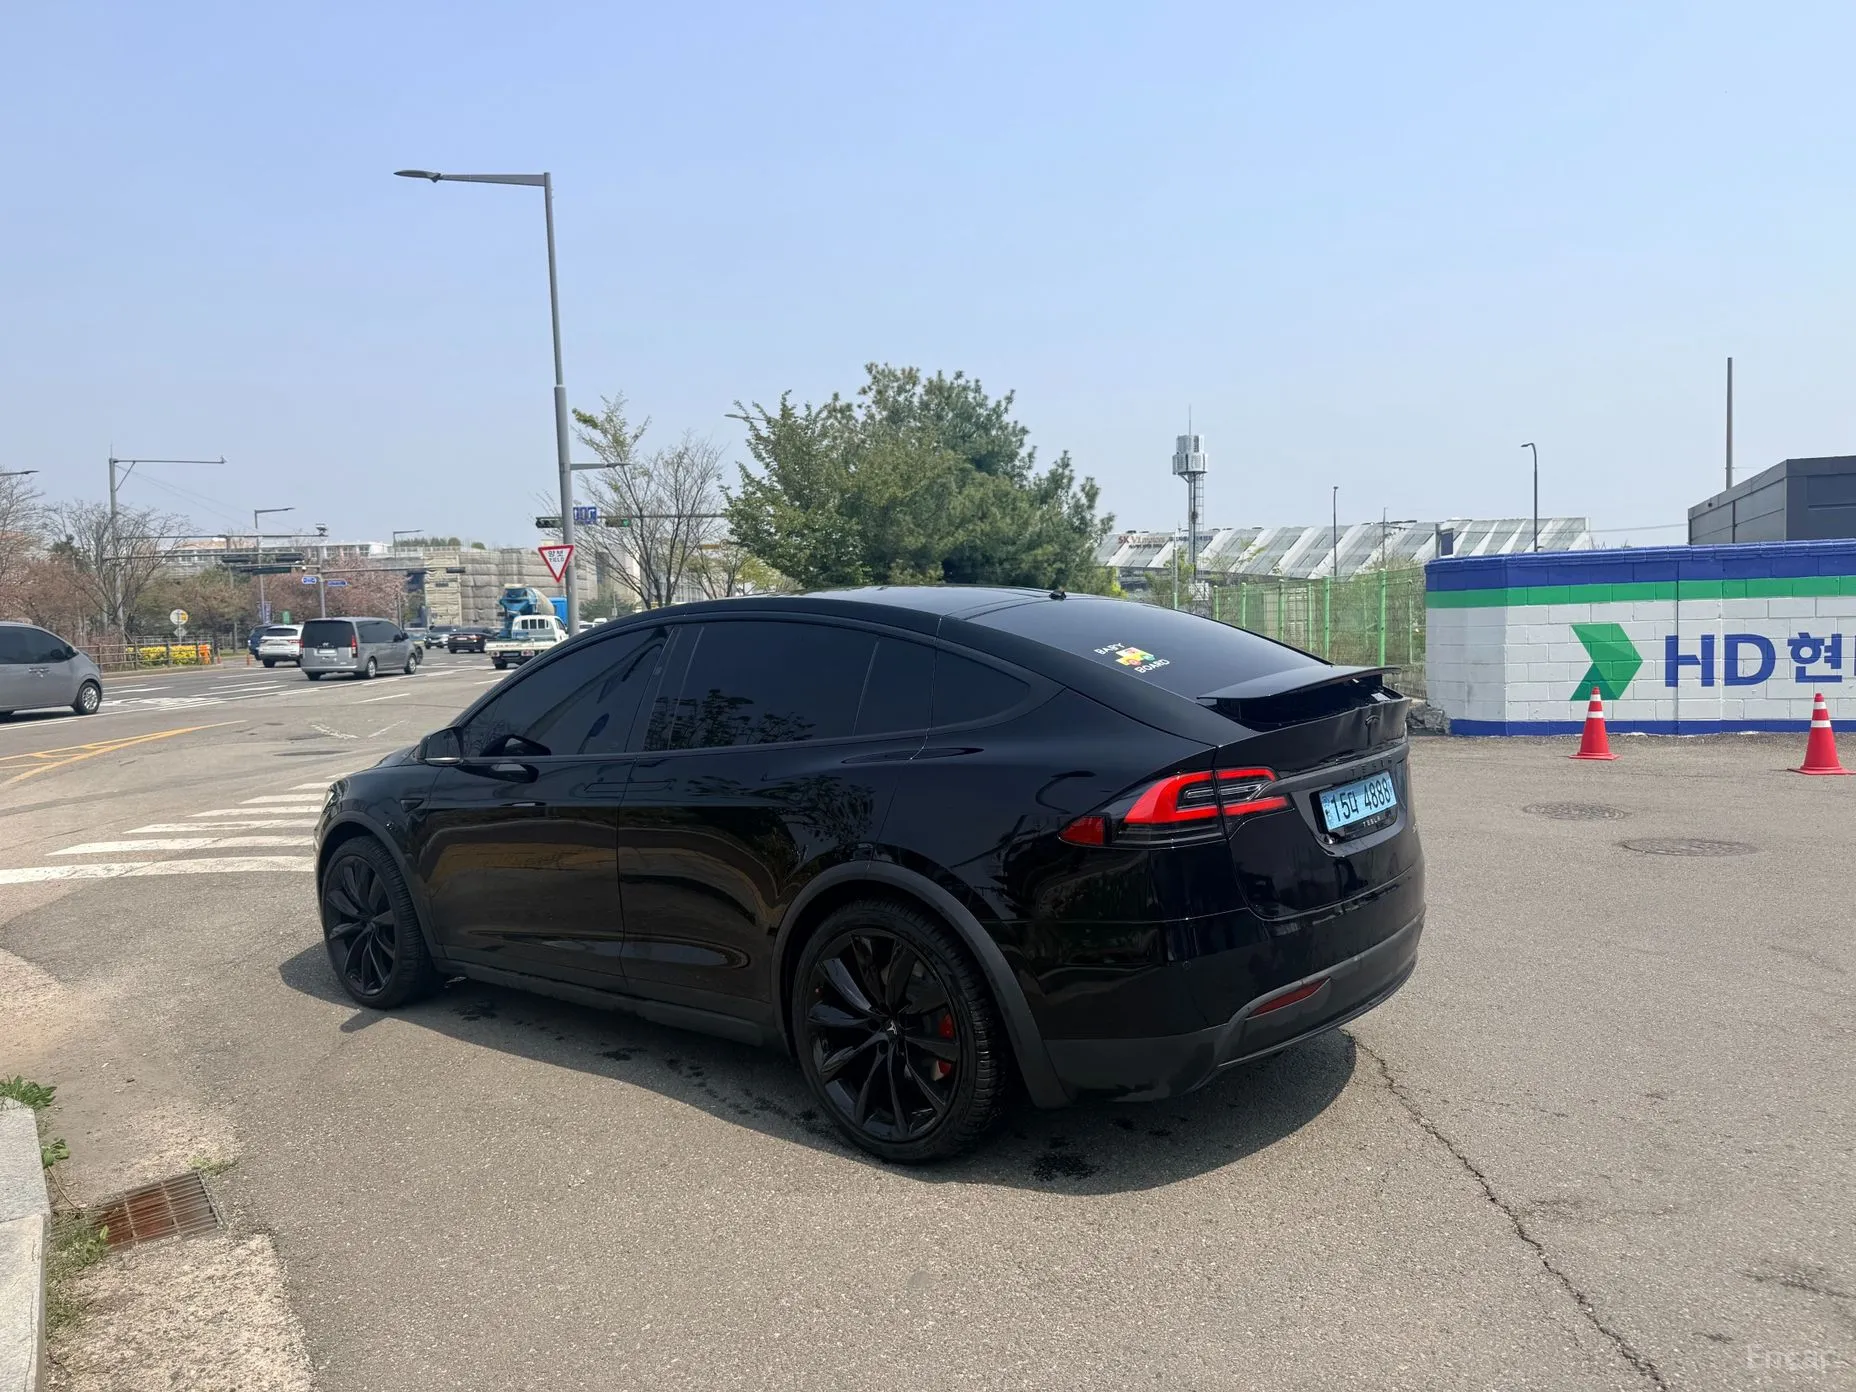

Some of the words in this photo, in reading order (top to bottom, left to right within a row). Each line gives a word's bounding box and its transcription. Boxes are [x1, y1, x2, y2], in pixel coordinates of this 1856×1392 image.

[1094, 642, 1125, 655] BABY
[1665, 632, 1856, 687] HD현
[1134, 658, 1170, 673] BOARD
[1363, 777, 1391, 810] 4888
